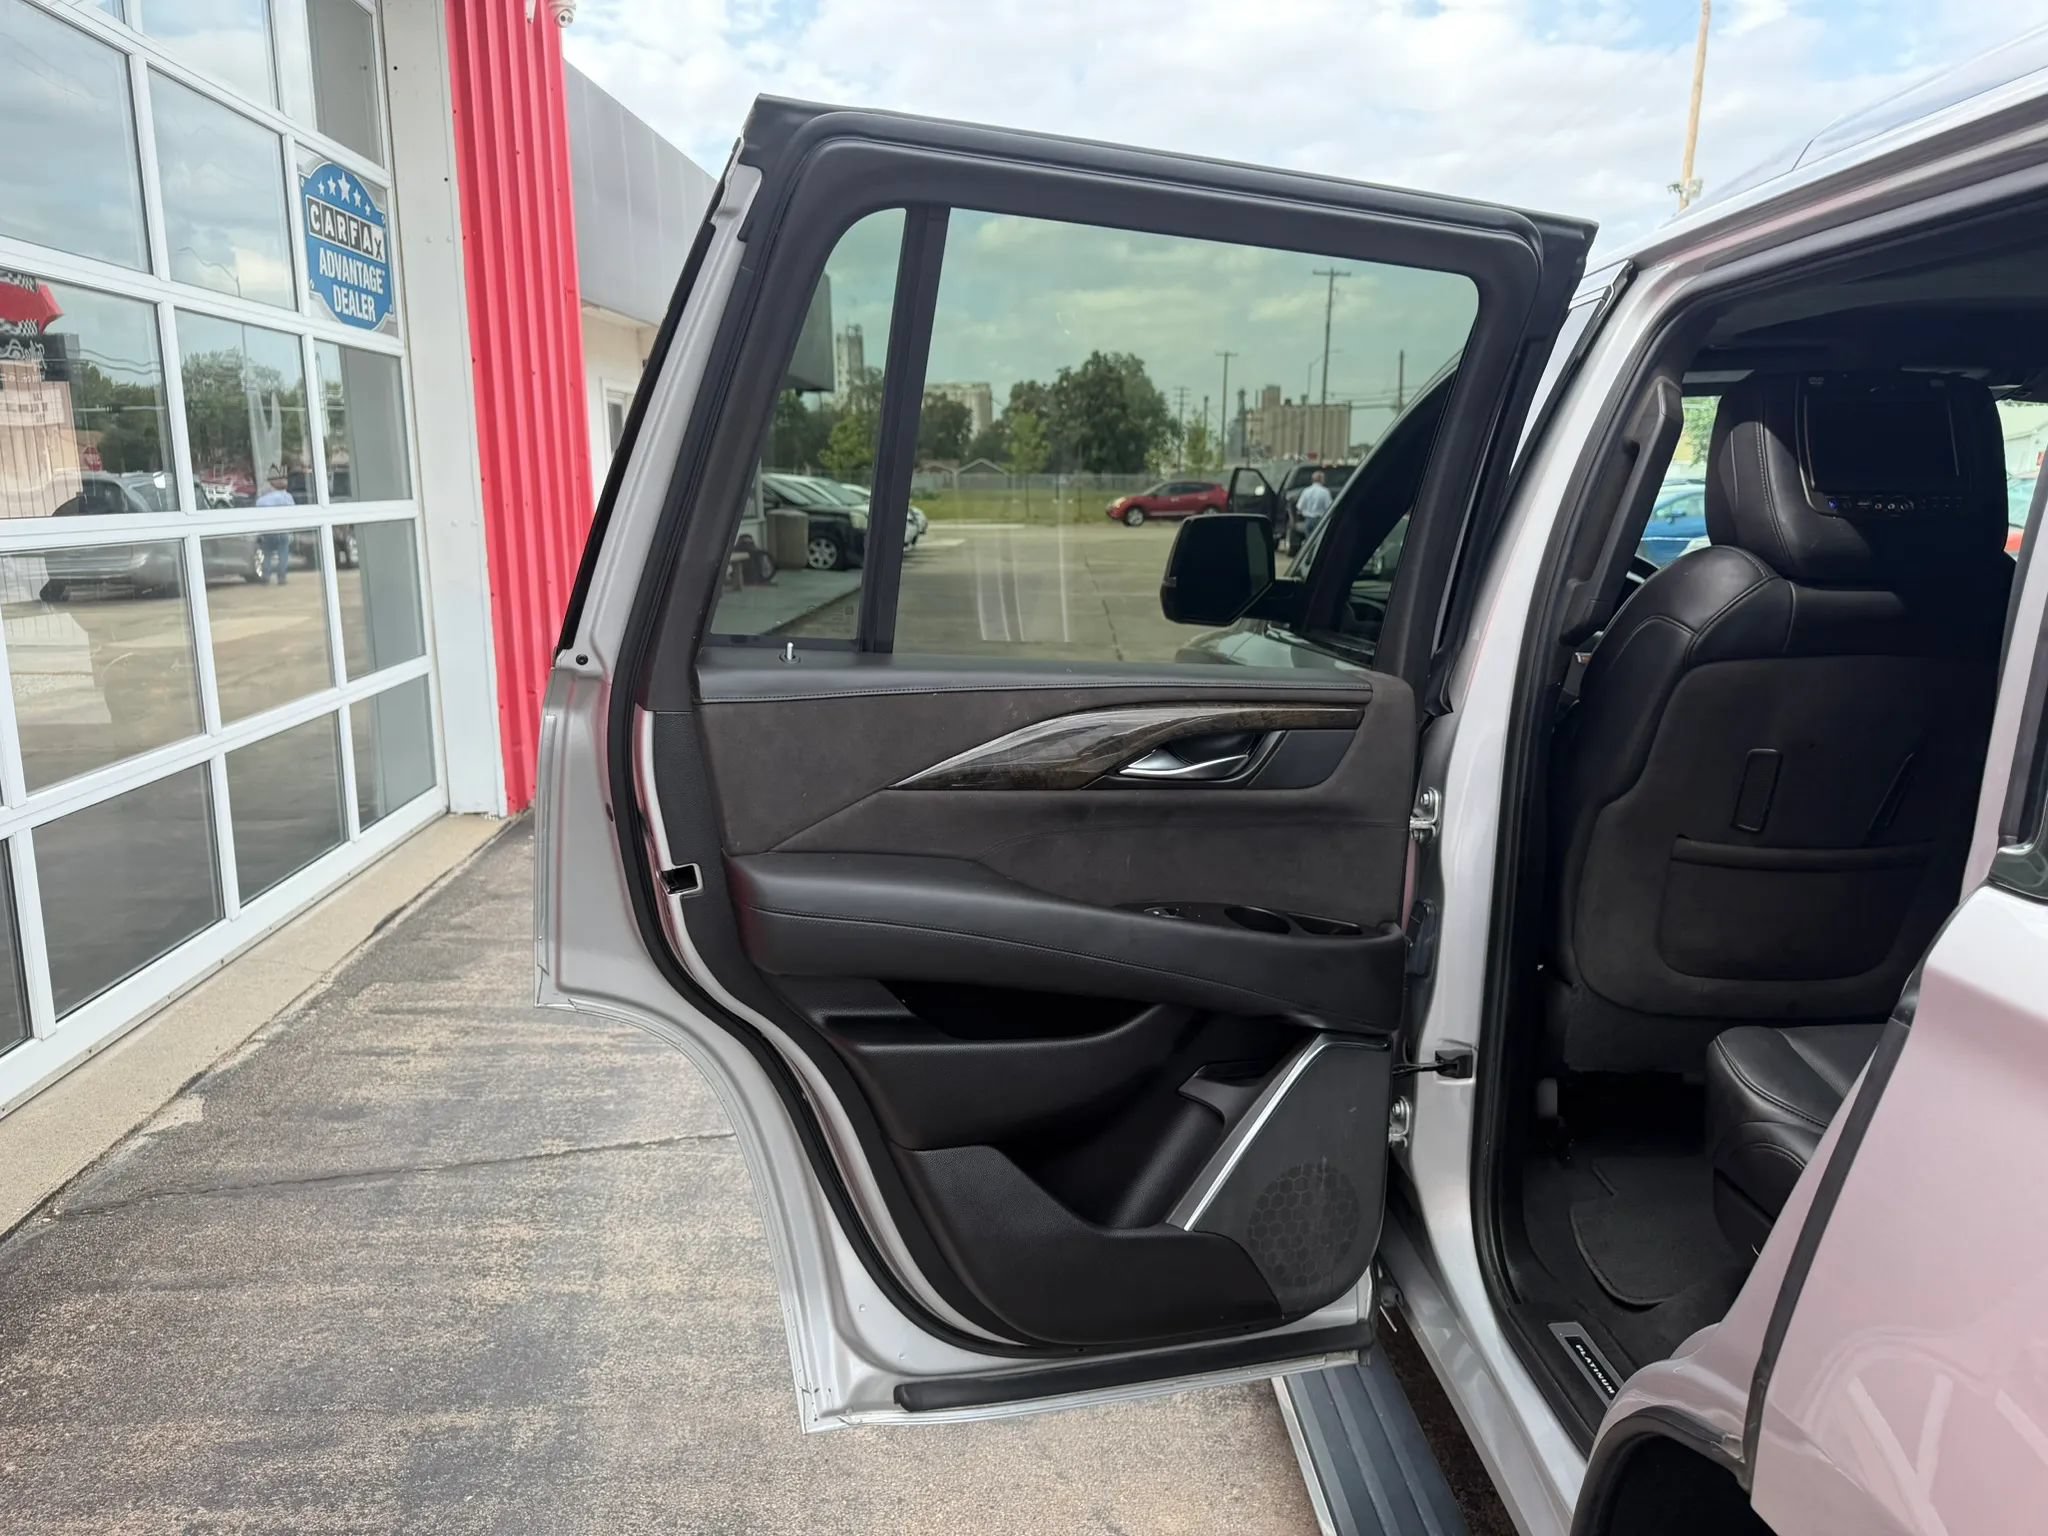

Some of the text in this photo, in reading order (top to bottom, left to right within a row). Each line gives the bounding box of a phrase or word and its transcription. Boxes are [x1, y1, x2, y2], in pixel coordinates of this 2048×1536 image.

[308, 202, 384, 260] CARFAX
[319, 247, 384, 295] ADVANTAGE
[333, 284, 376, 322] DEALER
[1575, 1344, 1616, 1394] PLATINUM
